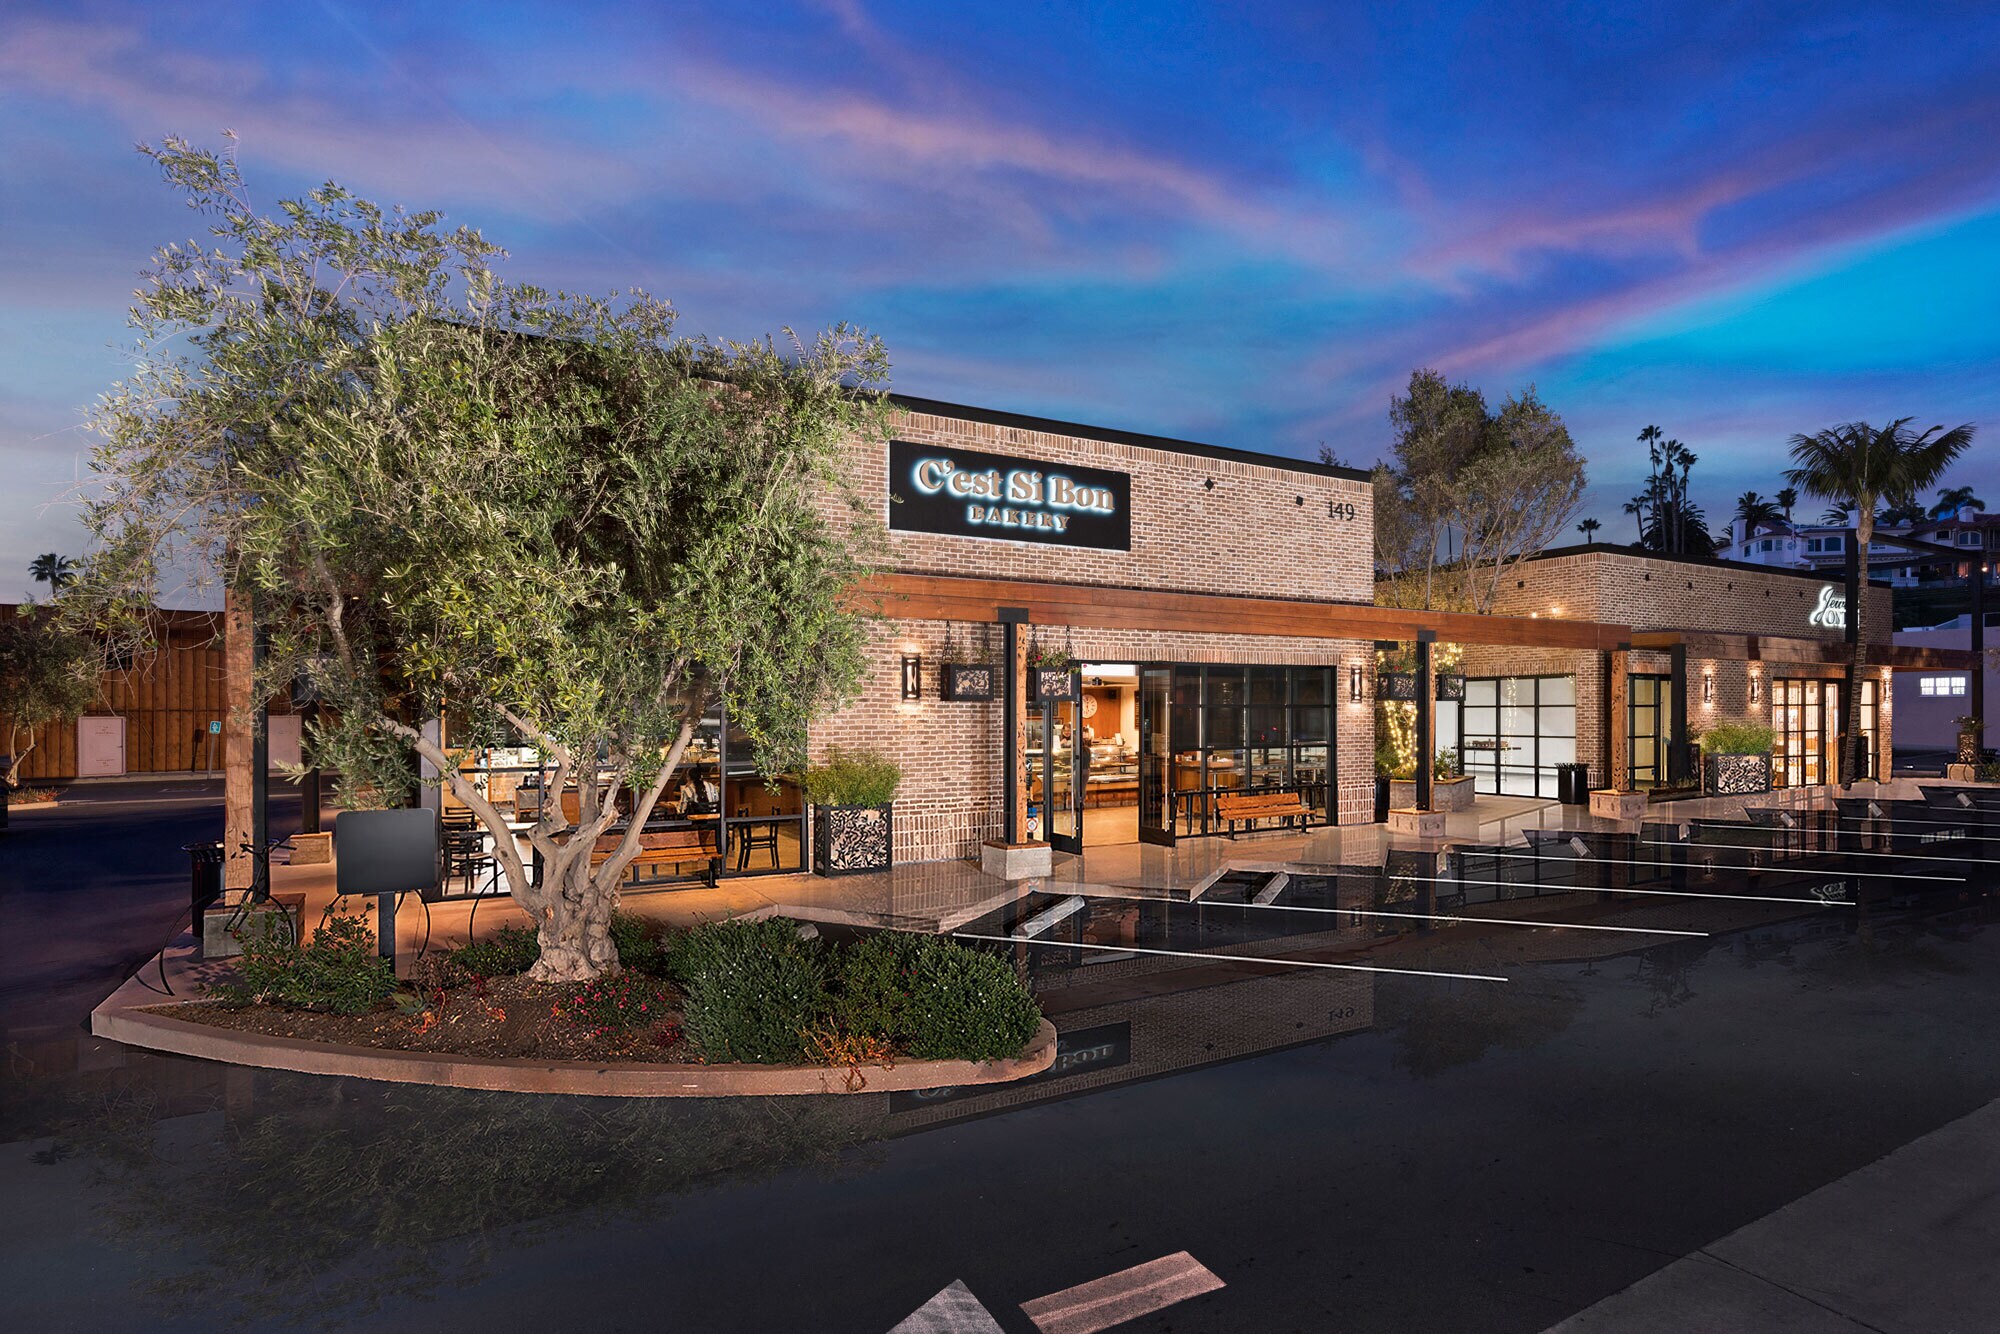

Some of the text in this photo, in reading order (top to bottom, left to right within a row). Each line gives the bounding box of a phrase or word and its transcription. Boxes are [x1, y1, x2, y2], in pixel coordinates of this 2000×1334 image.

[1010, 469, 1045, 502] Si
[1051, 476, 1116, 511] Bon
[971, 505, 1071, 530] BAKERY
[1327, 500, 1355, 521] 149
